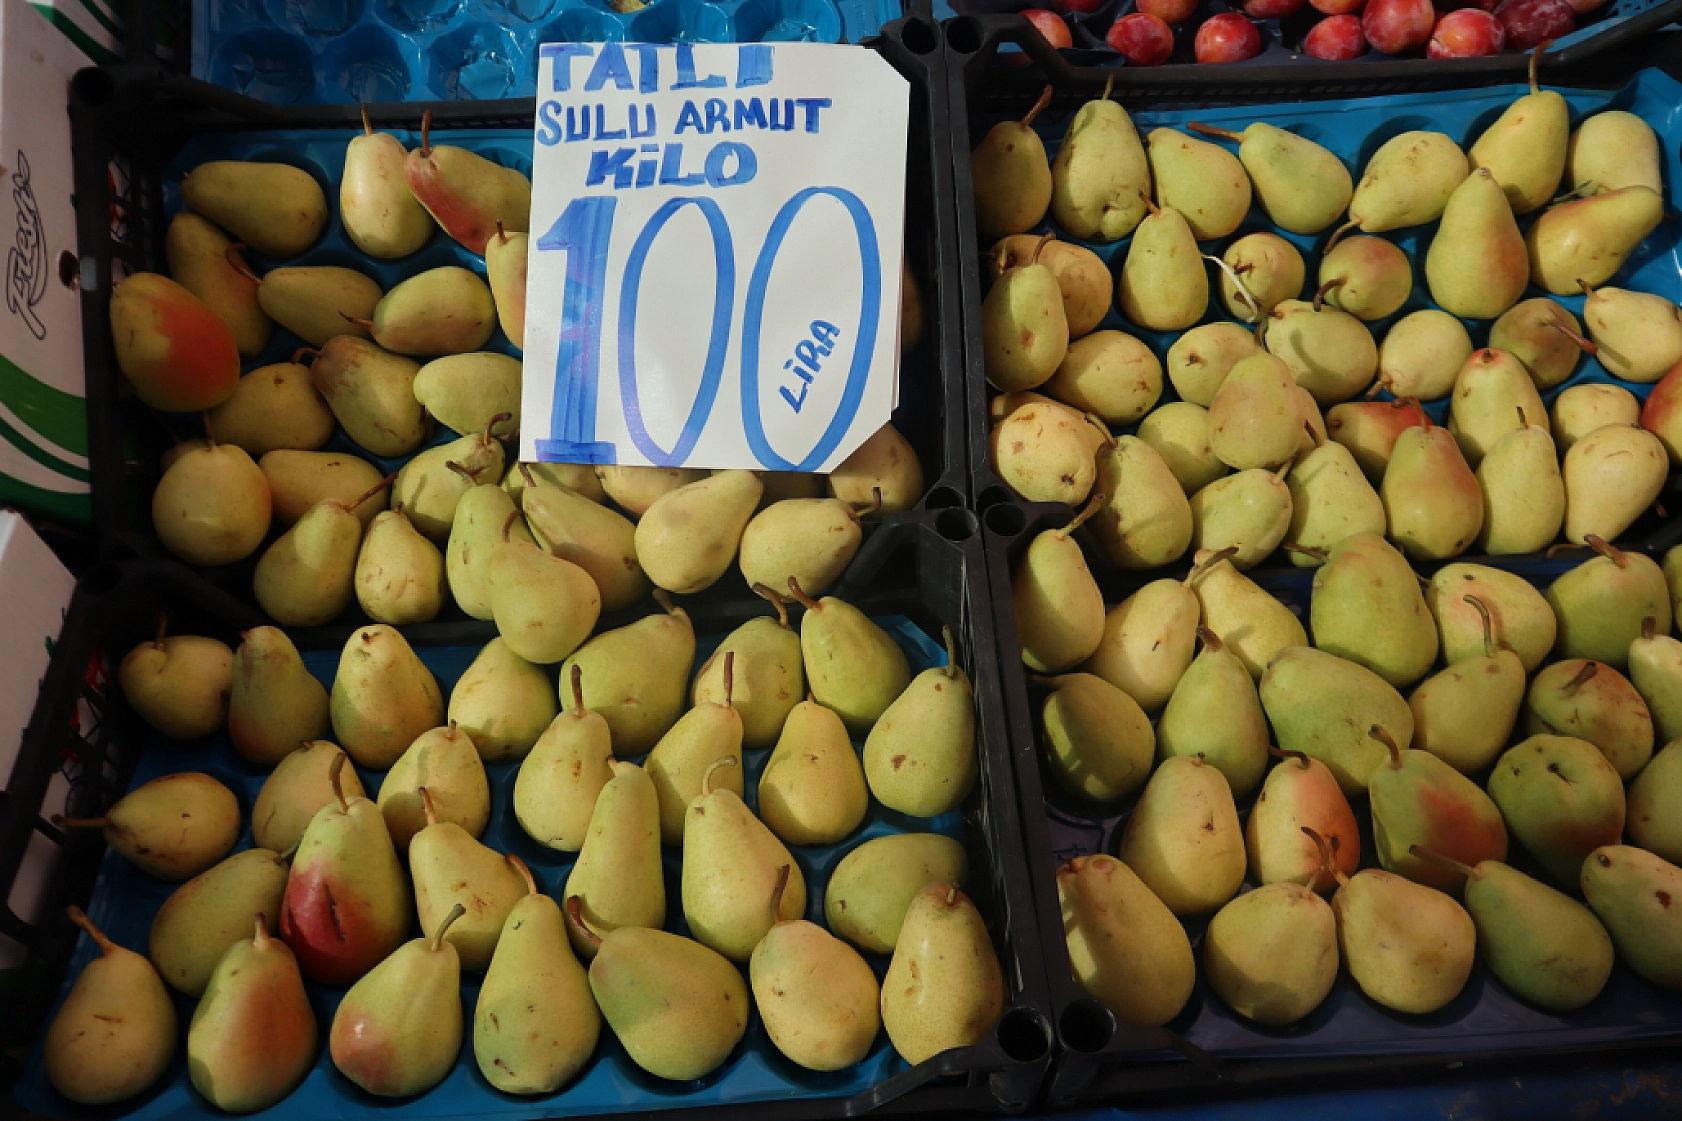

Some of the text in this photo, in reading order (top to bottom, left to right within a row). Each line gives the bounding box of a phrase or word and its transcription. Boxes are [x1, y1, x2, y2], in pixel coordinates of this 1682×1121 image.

[536, 97, 833, 146] SULU ARMUT
[534, 186, 882, 473] 100
